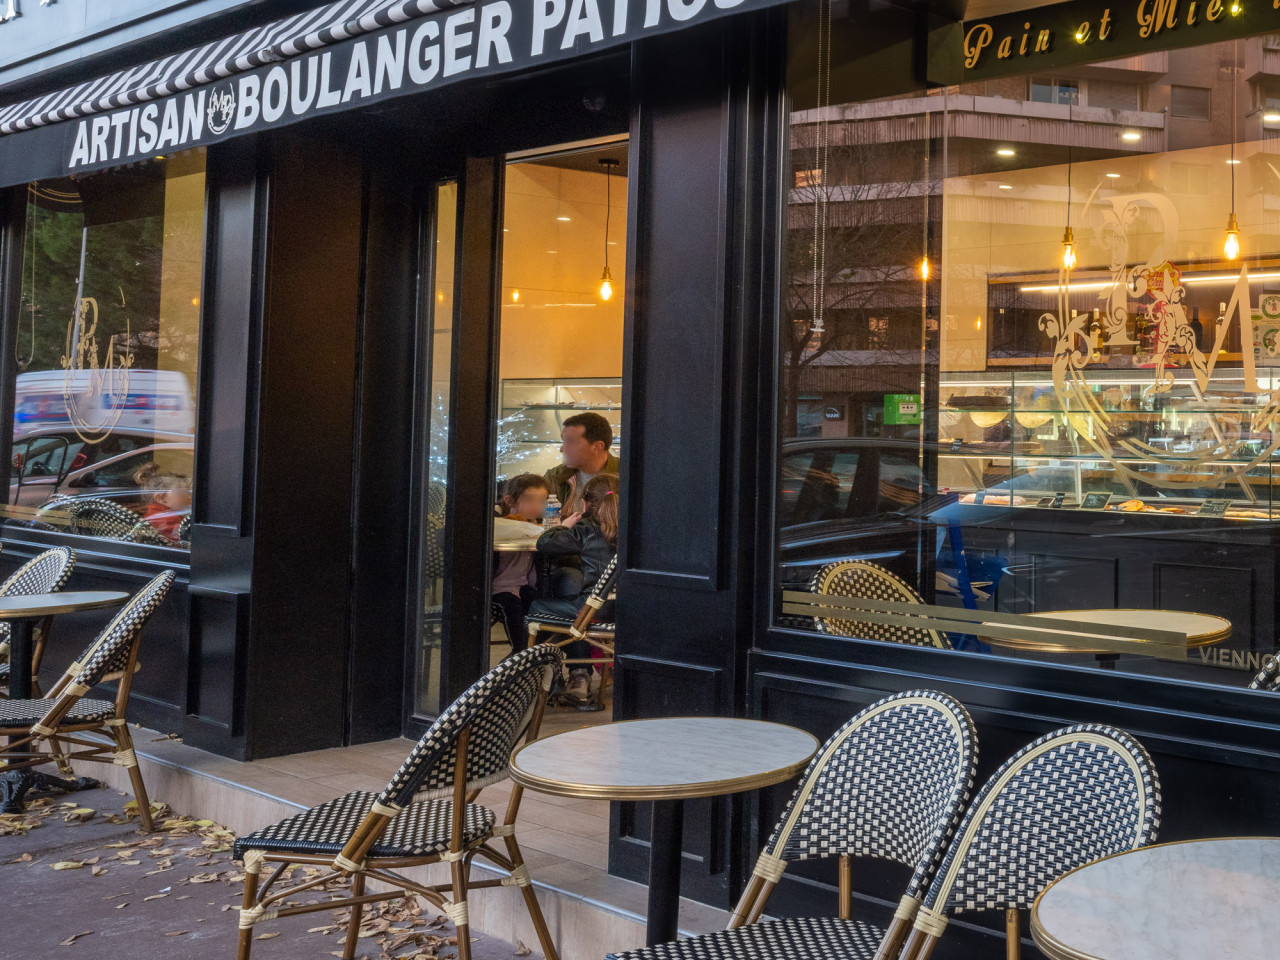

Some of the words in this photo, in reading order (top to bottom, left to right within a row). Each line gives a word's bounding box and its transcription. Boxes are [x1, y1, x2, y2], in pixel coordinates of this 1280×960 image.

[68, 89, 206, 169] ARTISAN
[233, 0, 513, 130] BOULANGER
[963, 20, 1050, 69] Pain
[1075, 8, 1111, 45] et
